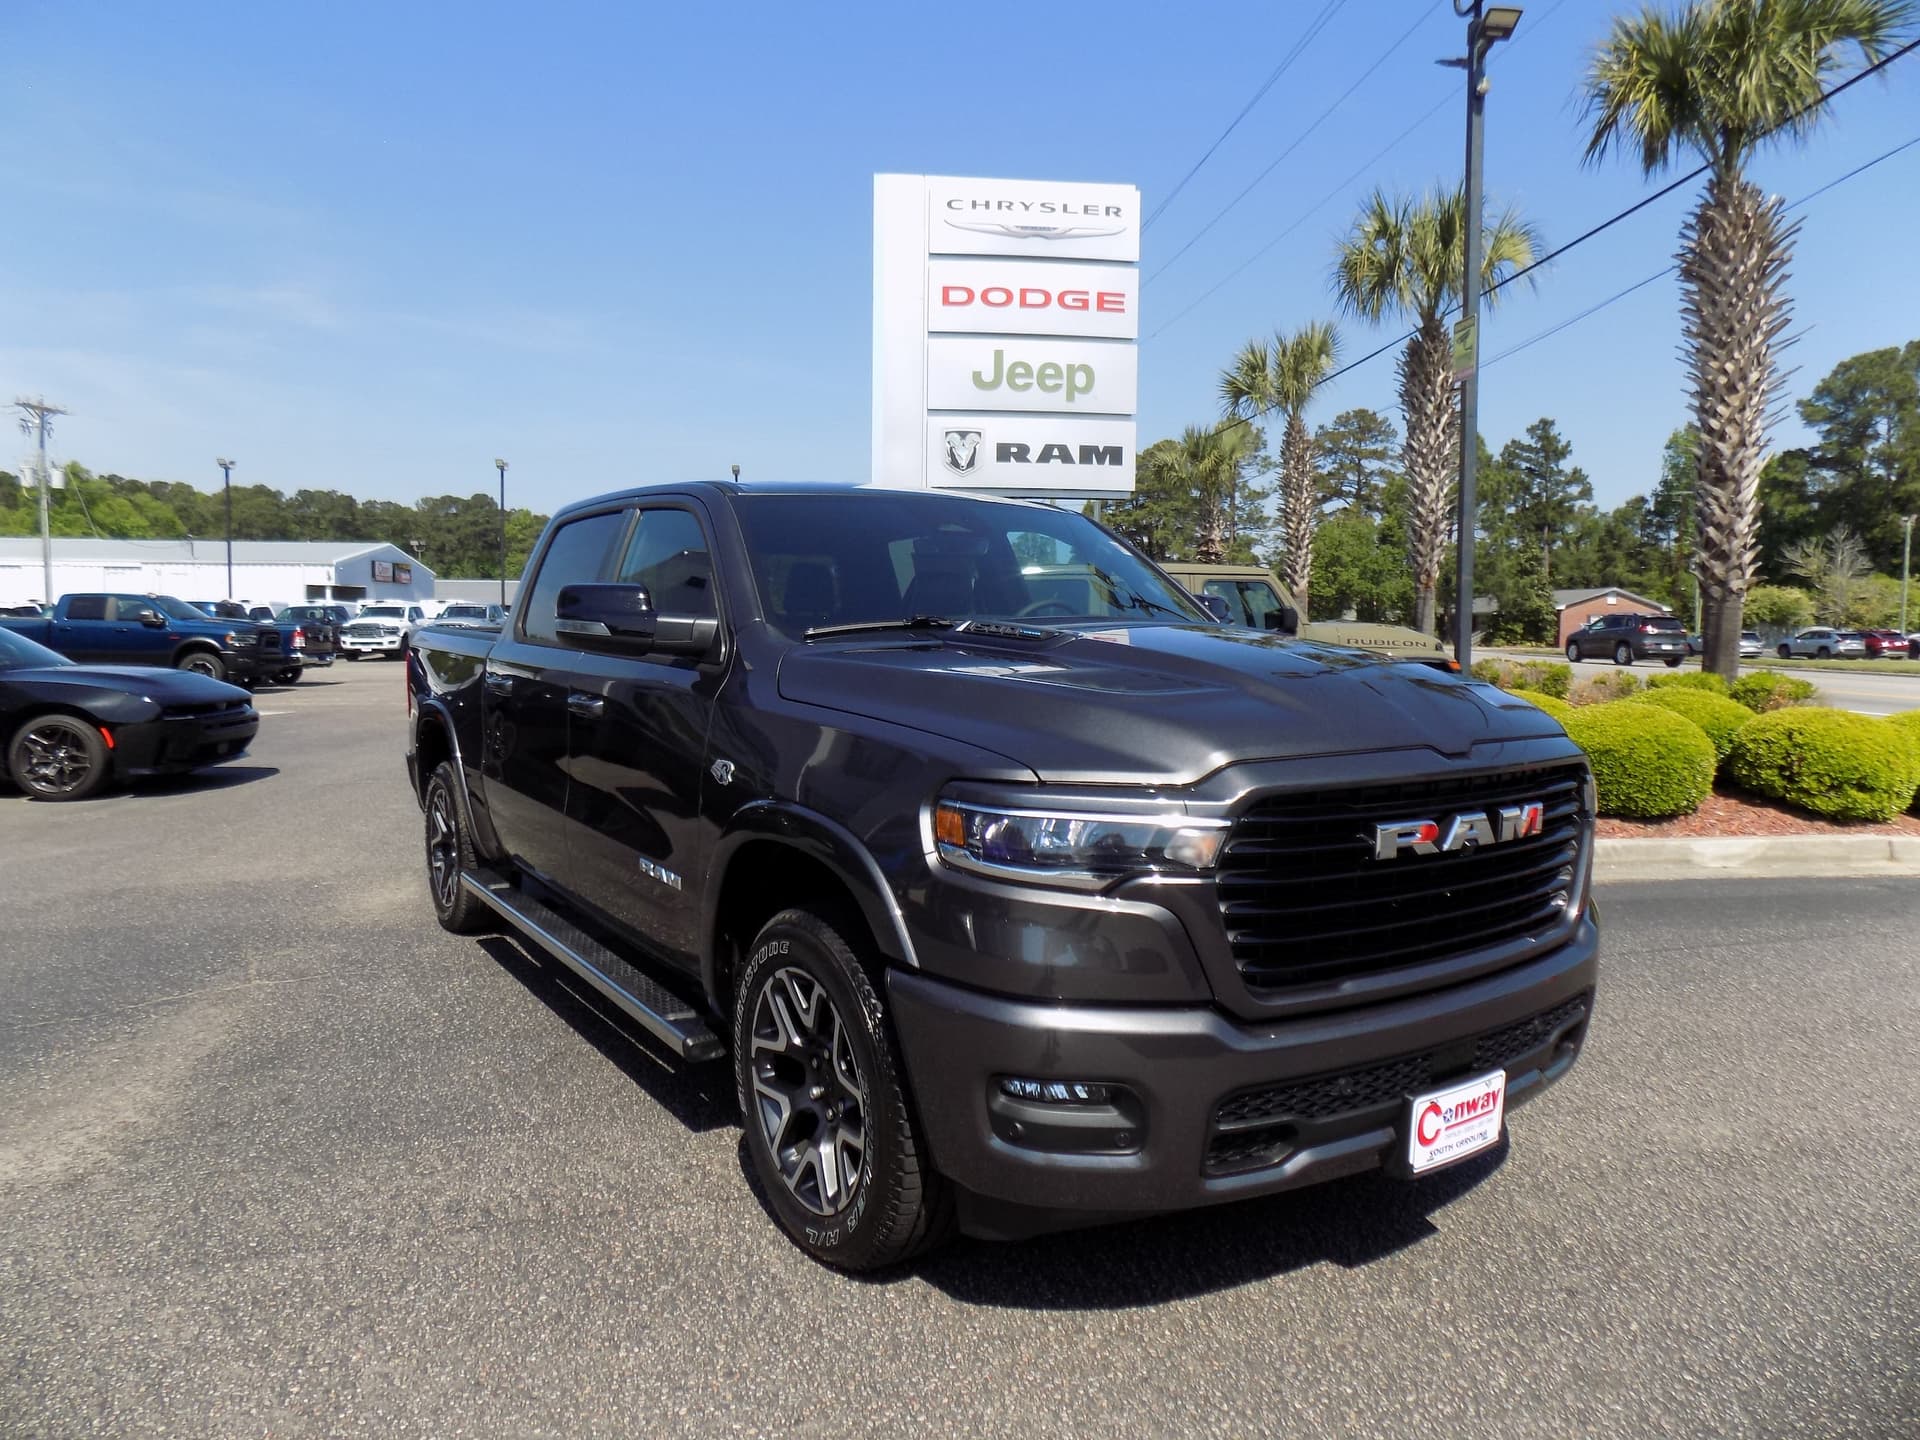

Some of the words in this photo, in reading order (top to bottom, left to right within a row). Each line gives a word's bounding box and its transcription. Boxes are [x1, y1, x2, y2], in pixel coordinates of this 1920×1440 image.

[946, 199, 1123, 217] CHRYSLER
[942, 286, 1126, 313] DODGE
[972, 349, 1095, 402] Jeep
[996, 442, 1123, 466] RAM
[1346, 638, 1427, 648] RUBICON
[1375, 802, 1543, 860] RAM
[639, 857, 682, 891] RAM
